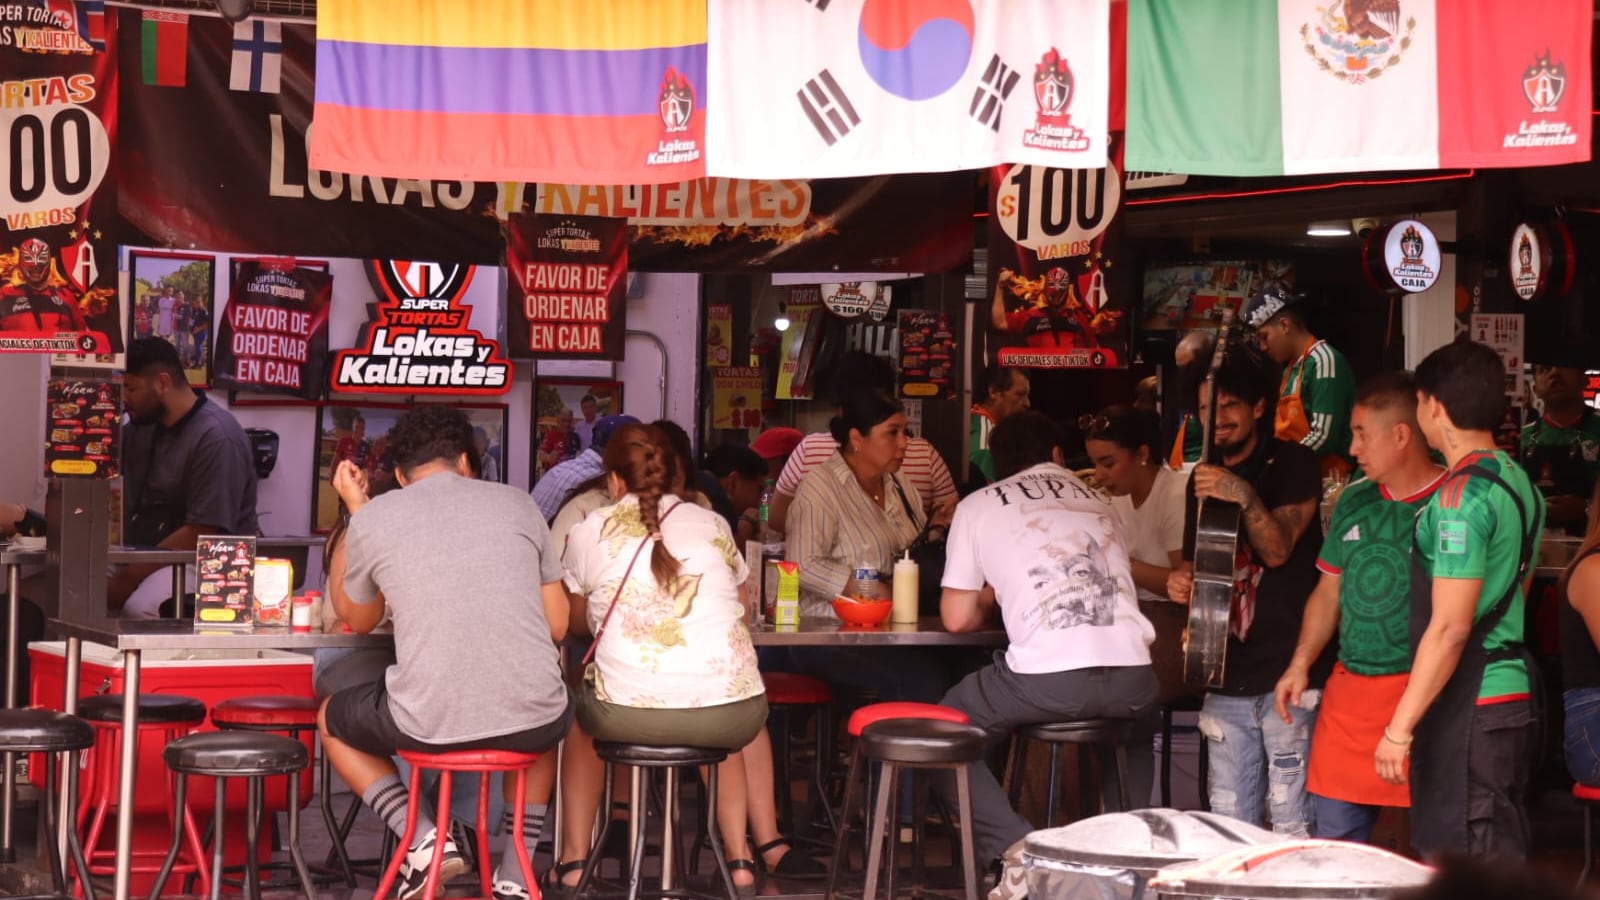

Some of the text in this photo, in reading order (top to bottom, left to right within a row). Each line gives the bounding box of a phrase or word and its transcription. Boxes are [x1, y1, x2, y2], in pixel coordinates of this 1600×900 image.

[0, 74, 95, 108] RTAS
[1519, 120, 1566, 134] Lokas
[659, 139, 696, 152] Lokas
[1503, 133, 1577, 147] Kalientes
[7, 207, 76, 231] VAROS
[537, 237, 560, 249] LOKAS
[1037, 240, 1090, 260] VAROS
[526, 264, 608, 290] FAVOR DE
[1401, 278, 1427, 287] CAJA
[247, 282, 270, 294] LOKAS
[400, 299, 449, 310] SUPER
[526, 295, 607, 320] ORDENAR
[235, 305, 311, 335] FAVOR DE
[388, 311, 462, 325] TORTAS
[46, 338, 77, 350] TIKTOK
[372, 329, 491, 363] Lokas y
[531, 325, 601, 350] EN CAJA
[233, 333, 308, 361] ORDENAR
[1003, 354, 1089, 366] LAS OFICIALES DE TIKTOK
[237, 359, 301, 387] EN CAJA
[338, 357, 506, 386] Kalientes
[716, 367, 760, 377] TORTAS
